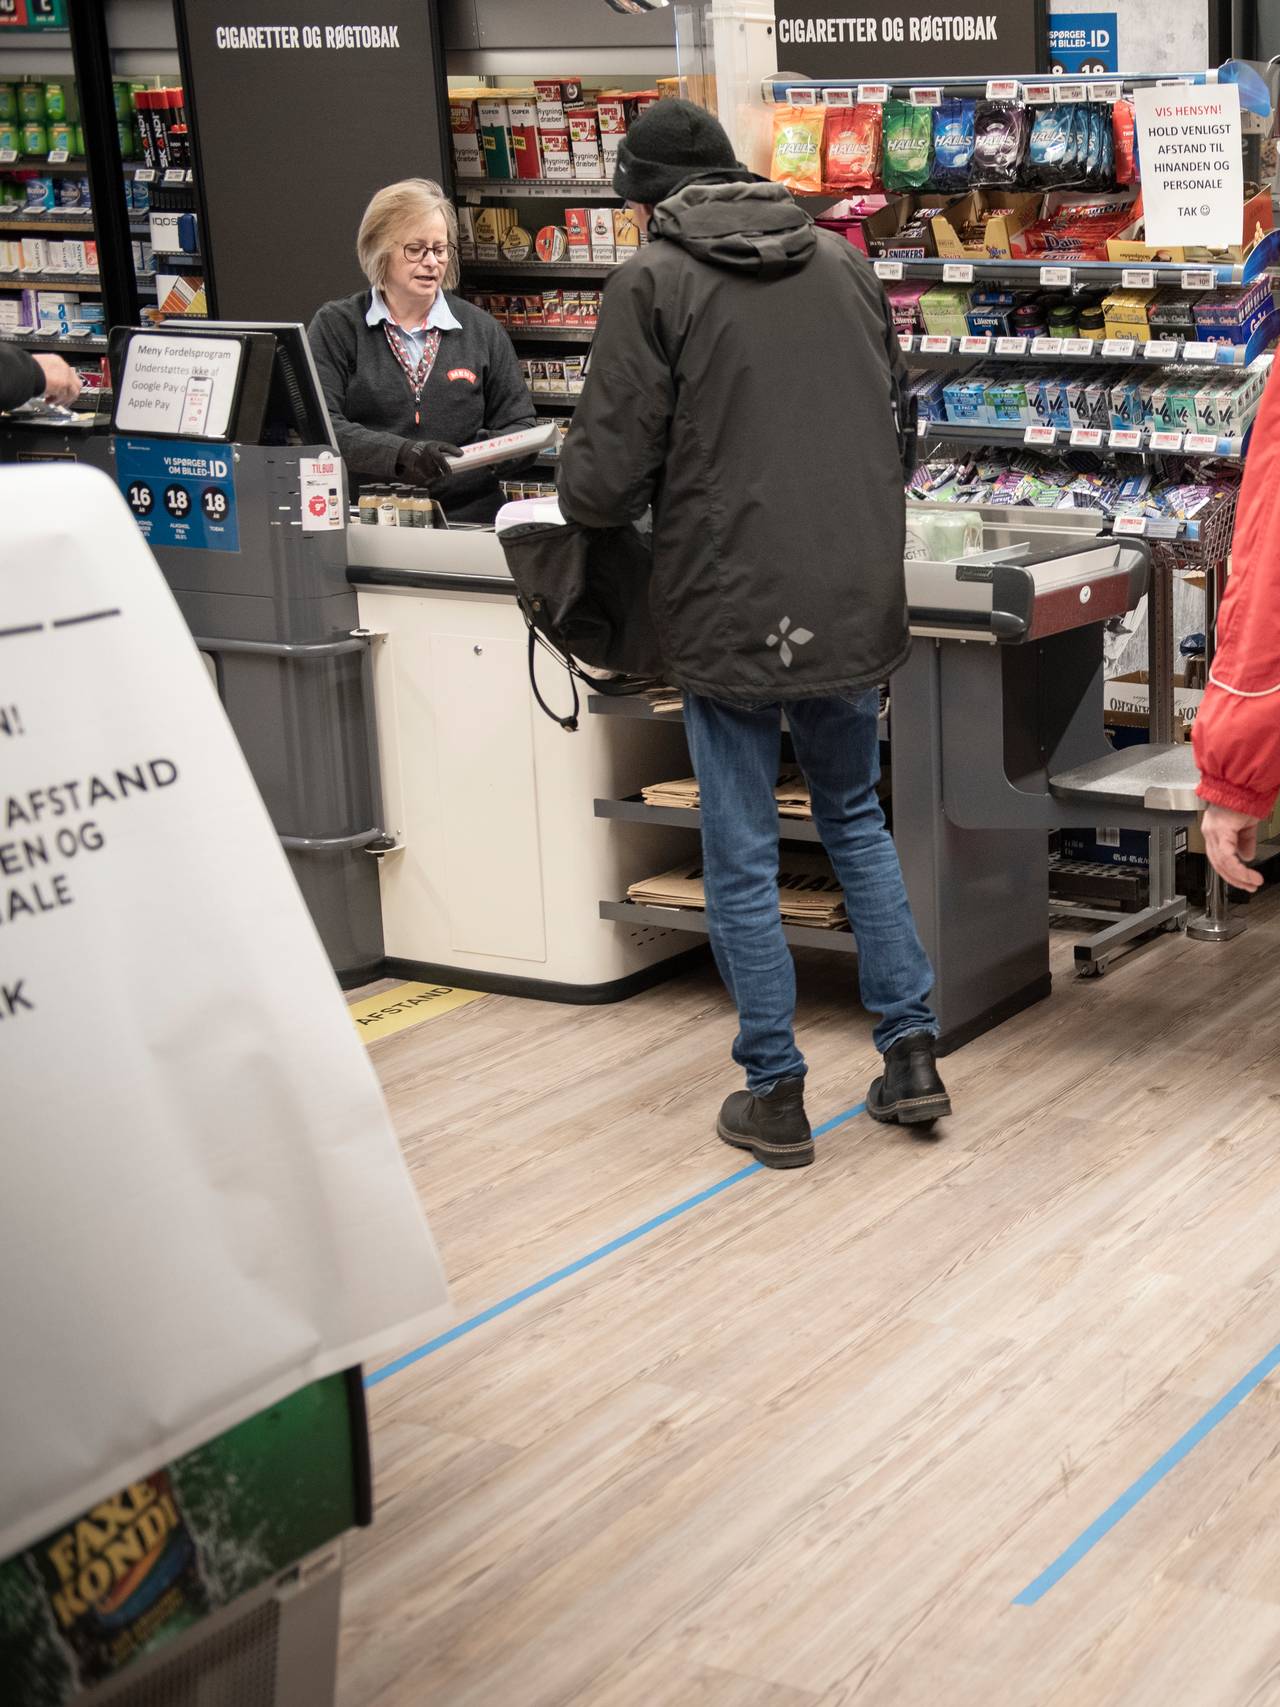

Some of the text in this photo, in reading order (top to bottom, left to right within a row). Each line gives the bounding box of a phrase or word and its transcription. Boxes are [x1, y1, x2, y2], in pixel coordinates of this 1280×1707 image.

[778, 15, 997, 43] CIGARETTER OG RØGTOBAK
[216, 24, 400, 50] CIGARETTER OG RØGTOBAK
[537, 108, 563, 117] Rygning
[599, 107, 618, 116] SUPER
[1155, 104, 1222, 118] VIS HENSYN!
[539, 115, 562, 123] dræber
[571, 121, 587, 129] SUPER
[1030, 131, 1067, 143] HALLS
[1148, 124, 1232, 138] HOLD VENLIGST
[544, 136, 560, 145] SUPER
[887, 138, 926, 151] HALLS
[934, 135, 973, 146] HALLS
[975, 135, 1016, 146] HALLS
[777, 143, 817, 154] HALLS
[829, 143, 870, 155] HALLS
[1157, 142, 1225, 155] AFSTAND TIL
[544, 158, 570, 168] Rygning
[573, 153, 599, 162] Rygning
[575, 160, 598, 168] dræber
[546, 164, 569, 173] dræber
[1154, 160, 1230, 173] HINANDEN OG
[1163, 179, 1223, 191] PERSONALE
[1177, 206, 1198, 217] TAK
[152, 217, 179, 226] IQOS
[1041, 232, 1082, 249] Daim
[888, 248, 924, 259] SNICKERS
[137, 345, 231, 360] Meny Fordelsprogram
[135, 363, 190, 376] Understøttes
[191, 366, 209, 376] ikke
[131, 380, 179, 393] Google Pay
[128, 397, 171, 412] Apple Pay
[1029, 393, 1046, 417] V6
[1114, 400, 1131, 421] V6
[1155, 402, 1172, 425] V6
[1199, 405, 1216, 427] V6
[172, 457, 207, 468] SPØRGER
[311, 463, 334, 474] TILBUD
[168, 466, 180, 475] OM
[130, 487, 151, 506] 16
[167, 489, 188, 509] 18
[204, 493, 226, 512] 18
[4, 757, 180, 830] AFSTAND
[56, 820, 106, 858] OG
[355, 986, 454, 1027] AFSTAND
[48, 1480, 157, 1582] FAXE
[51, 1496, 181, 1629] KONDI
